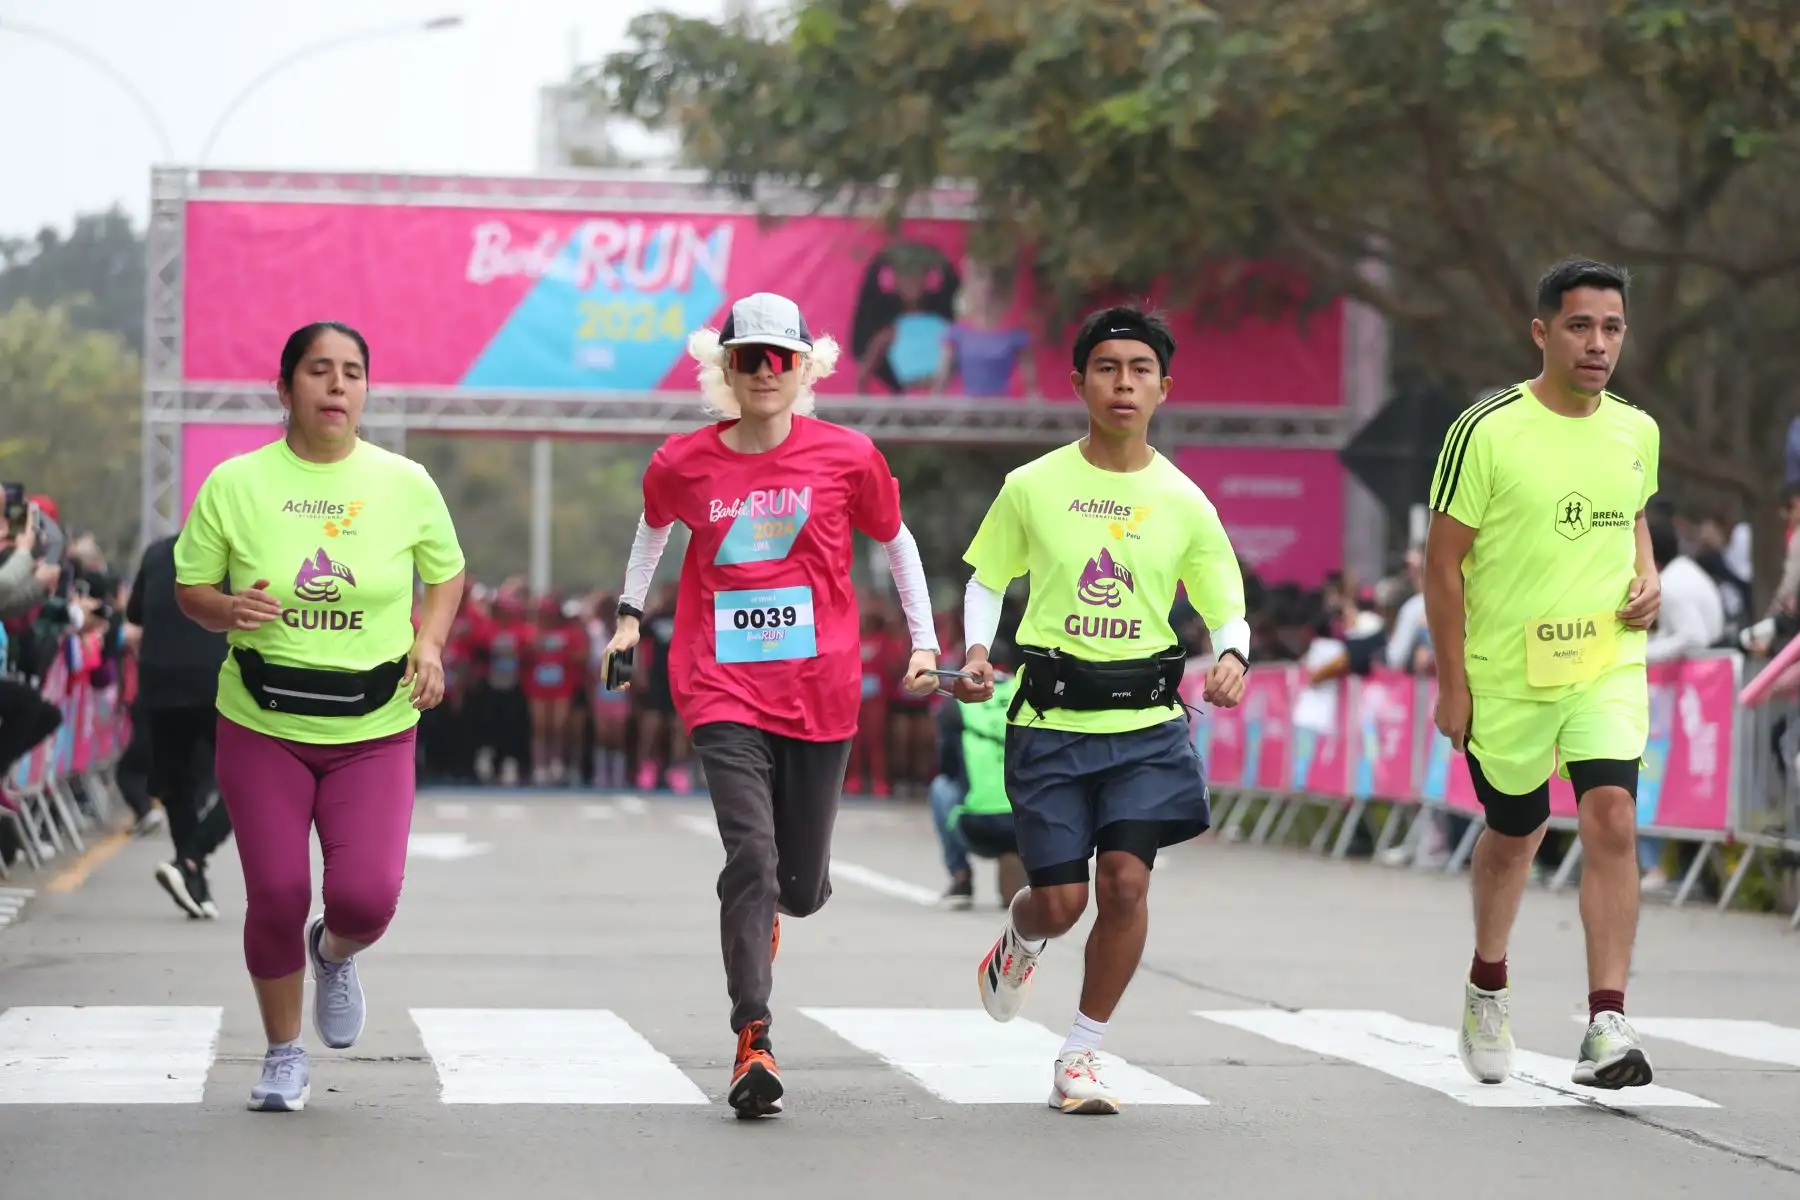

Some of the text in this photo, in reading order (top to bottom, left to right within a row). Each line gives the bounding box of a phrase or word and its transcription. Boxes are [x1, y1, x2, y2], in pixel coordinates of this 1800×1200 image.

[575, 217, 735, 293] RUN
[577, 300, 685, 341] 2024
[282, 499, 345, 515] Achilles
[709, 486, 813, 523] Barbie RUN
[1068, 498, 1132, 517] Achilles
[1592, 509, 1625, 519] BREÑA
[752, 521, 794, 540] 2024
[1126, 531, 1141, 540] Peru
[282, 608, 364, 631] GUIDE
[733, 605, 797, 630] 0039
[1064, 614, 1142, 640] GUIDE
[1536, 617, 1597, 642] GUÍA
